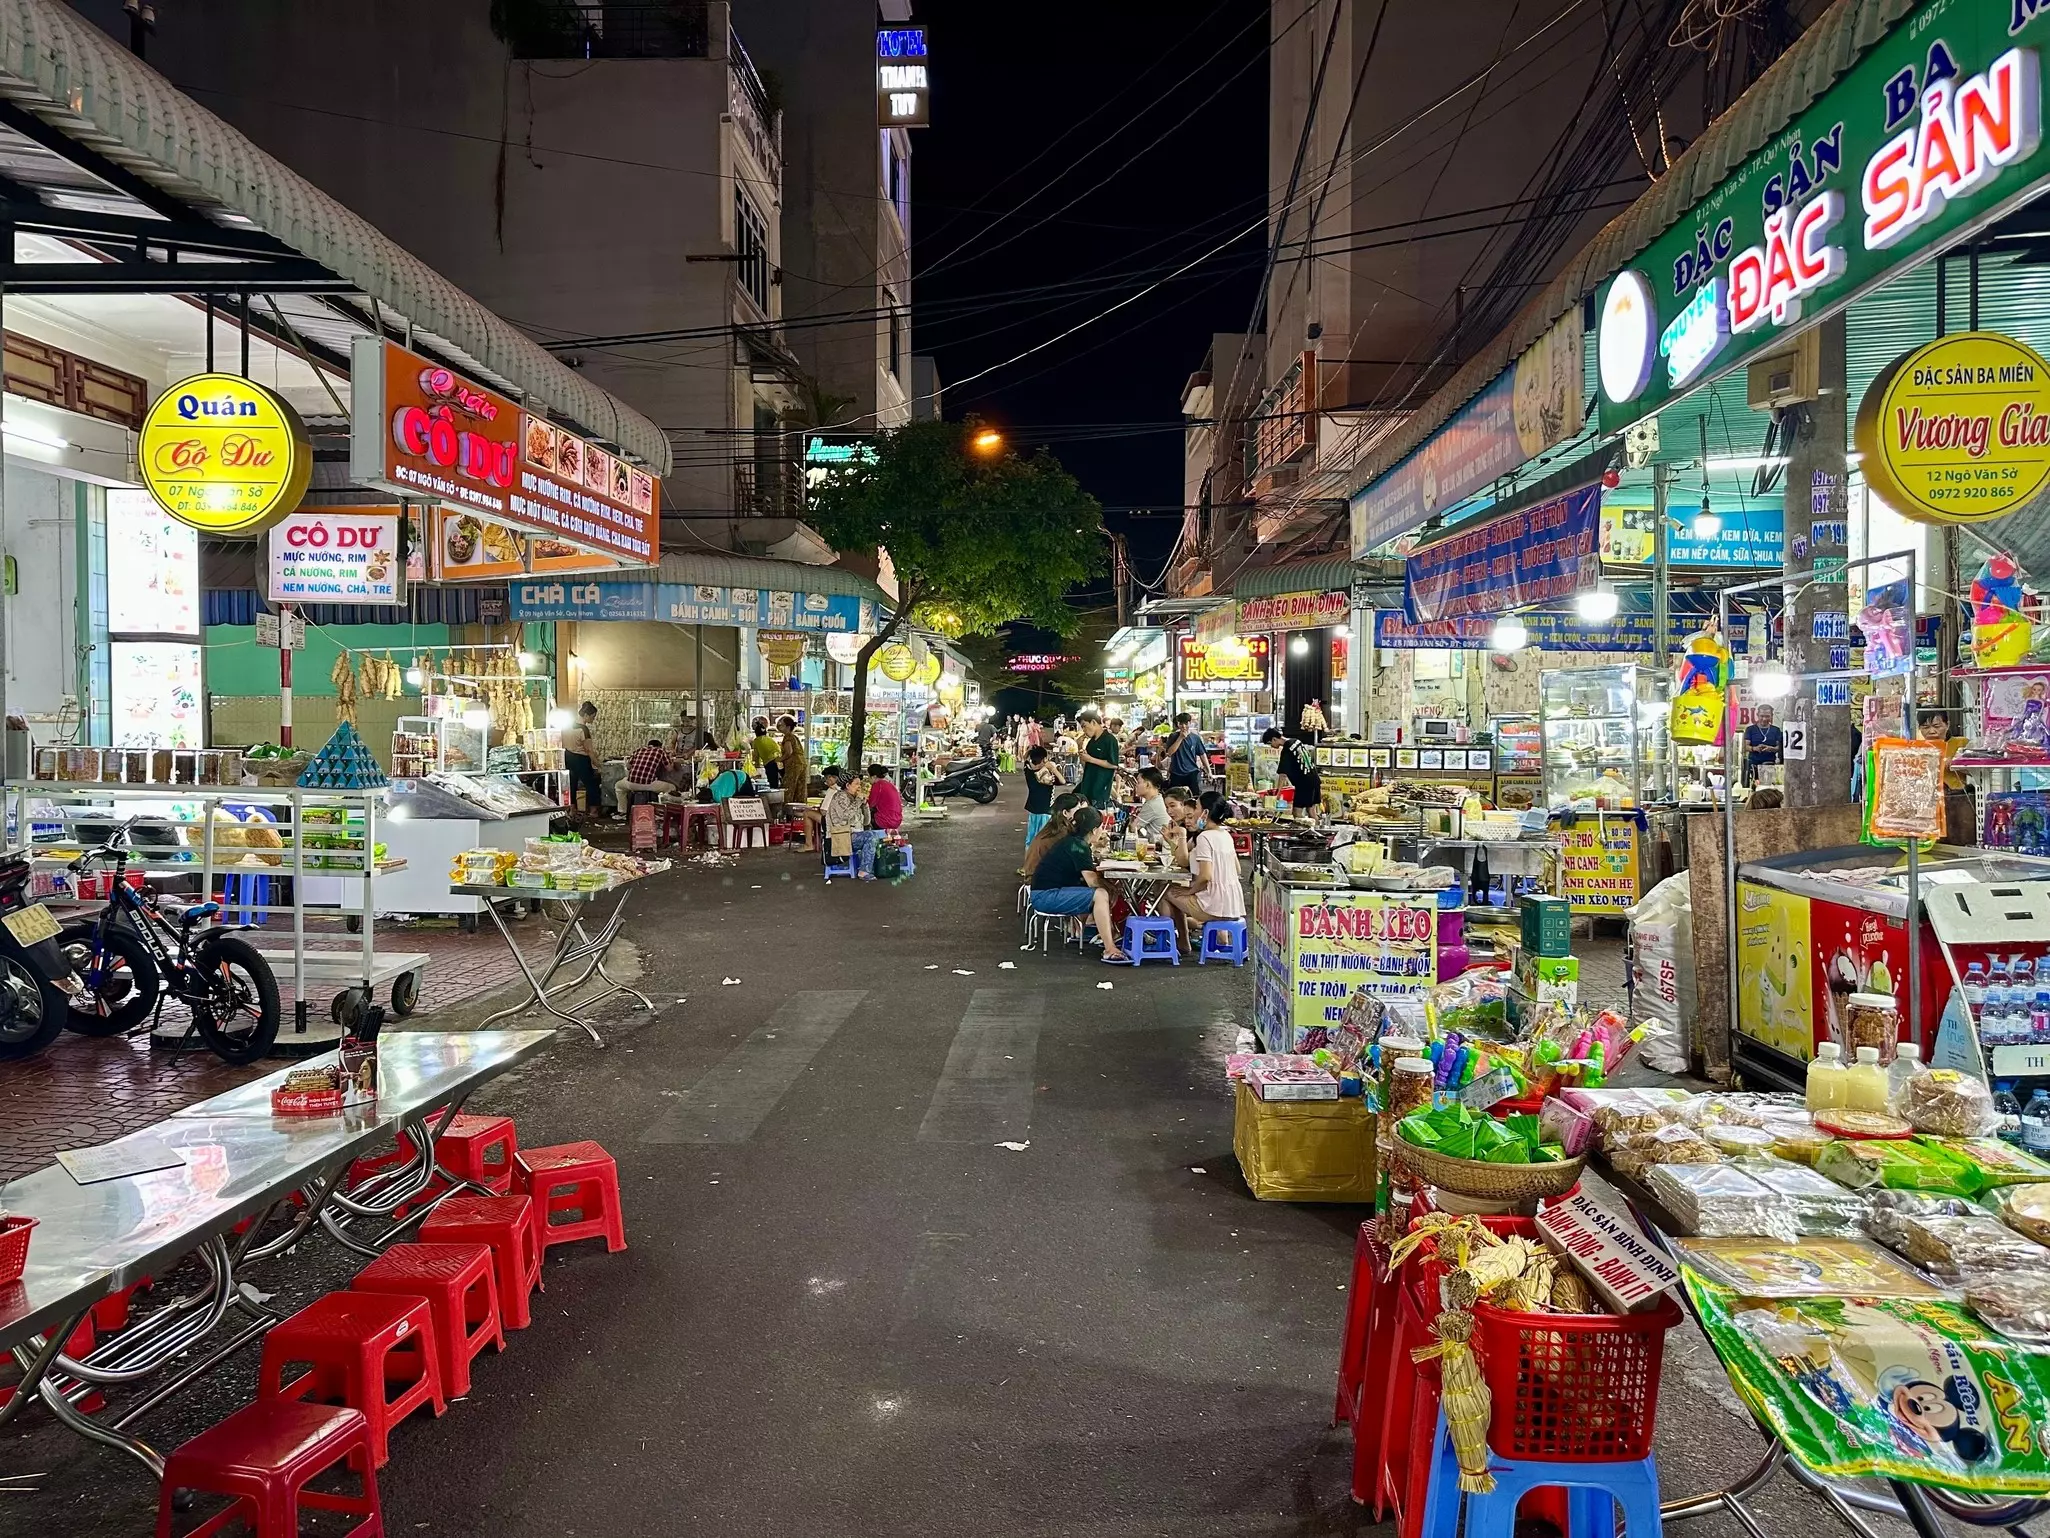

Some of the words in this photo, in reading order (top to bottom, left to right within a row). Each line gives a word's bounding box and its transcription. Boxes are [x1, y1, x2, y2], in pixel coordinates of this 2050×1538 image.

[879, 30, 927, 56] HOTEL
[1674, 216, 1733, 297] ĐẶC
[1762, 121, 1844, 221] SẢN
[1883, 38, 1960, 132] BA
[1660, 277, 1717, 358] CHUYÊN
[1729, 190, 1838, 334] ĐẶC
[1862, 48, 2032, 251] SẢN
[1914, 366, 1942, 390] ĐẶC
[1946, 363, 1973, 385] SẢN
[1977, 367, 1995, 384] BA
[1999, 361, 2034, 383] MIỀN
[420, 368, 498, 421] Quán
[178, 395, 257, 420] Quán
[1896, 406, 1992, 459] Vương
[1998, 401, 2050, 446] Gia
[155, 440, 211, 477] Cô
[221, 434, 275, 466] Dư
[396, 404, 458, 466] CÔ
[462, 431, 517, 488] DƯ
[1927, 471, 1941, 482] 12
[1945, 469, 1971, 483] Ngô
[1974, 469, 1998, 480] Văn
[2001, 467, 2018, 479] Sở
[169, 486, 183, 497] 07
[248, 485, 264, 497] Sở
[1929, 488, 1960, 499] 0972
[1963, 488, 1987, 498] 920
[1991, 486, 2014, 497] 865
[287, 521, 328, 547] CÔ
[337, 526, 383, 548] DƯ
[1721, 530, 1740, 541] KEM
[1764, 531, 1783, 542] KEM
[283, 551, 305, 563] MỰC
[308, 552, 345, 564] NƯỚNG,
[348, 554, 366, 562] RIM
[1671, 547, 1689, 559] KEM
[1691, 544, 1708, 560] NẾP
[1710, 542, 1731, 562] CẨM,
[1752, 551, 1774, 562] CHUA
[283, 566, 296, 576] CÁ
[299, 567, 335, 578] NƯỚNG,
[339, 569, 358, 578] RIM
[283, 583, 304, 592] NEM
[308, 582, 344, 594] NƯỚNG,
[347, 581, 370, 595] CHẢ,
[373, 582, 392, 594] TRÉ
[521, 582, 565, 604] CHẢ
[571, 582, 600, 604] CÁ
[671, 601, 698, 619] BÁNH
[701, 606, 729, 621] CANH
[738, 604, 758, 622] BÚN
[796, 611, 820, 629] BÁNH
[822, 611, 846, 630] CUỐN
[1241, 598, 1267, 621] BÁNH
[1267, 596, 1288, 618] XÈO
[1291, 593, 1316, 616] BÌNH
[1577, 856, 1599, 870] CANH
[1562, 876, 1585, 889] ÁNH
[1587, 878, 1616, 889] CANH
[1619, 878, 1633, 892] HẸ
[1562, 892, 1585, 905] ÁNH
[1588, 892, 1609, 905] XÈO
[1611, 895, 1633, 910] MẸT
[1299, 903, 1374, 939] BÁNH
[1376, 902, 1432, 942] XÈO
[1299, 952, 1318, 968] BÚN
[1320, 953, 1339, 971] THỊT
[1341, 952, 1372, 970] NƯỚNG
[1379, 954, 1404, 971] BÁNH
[1298, 980, 1316, 996] TRÉ
[1320, 981, 1347, 1000] TRỘN
[2025, 1057, 2044, 1067] TH
[1571, 1196, 1597, 1220] ĐẶC
[1592, 1215, 1620, 1236] SẢN
[1613, 1232, 1647, 1258] BÌNH
[1639, 1254, 1677, 1283] ĐỊNH
[1538, 1205, 1576, 1235] BÁNH
[1562, 1228, 1605, 1261] HỒNG
[1593, 1257, 1641, 1291] BÁNH
[1621, 1280, 1655, 1301] ÍT
